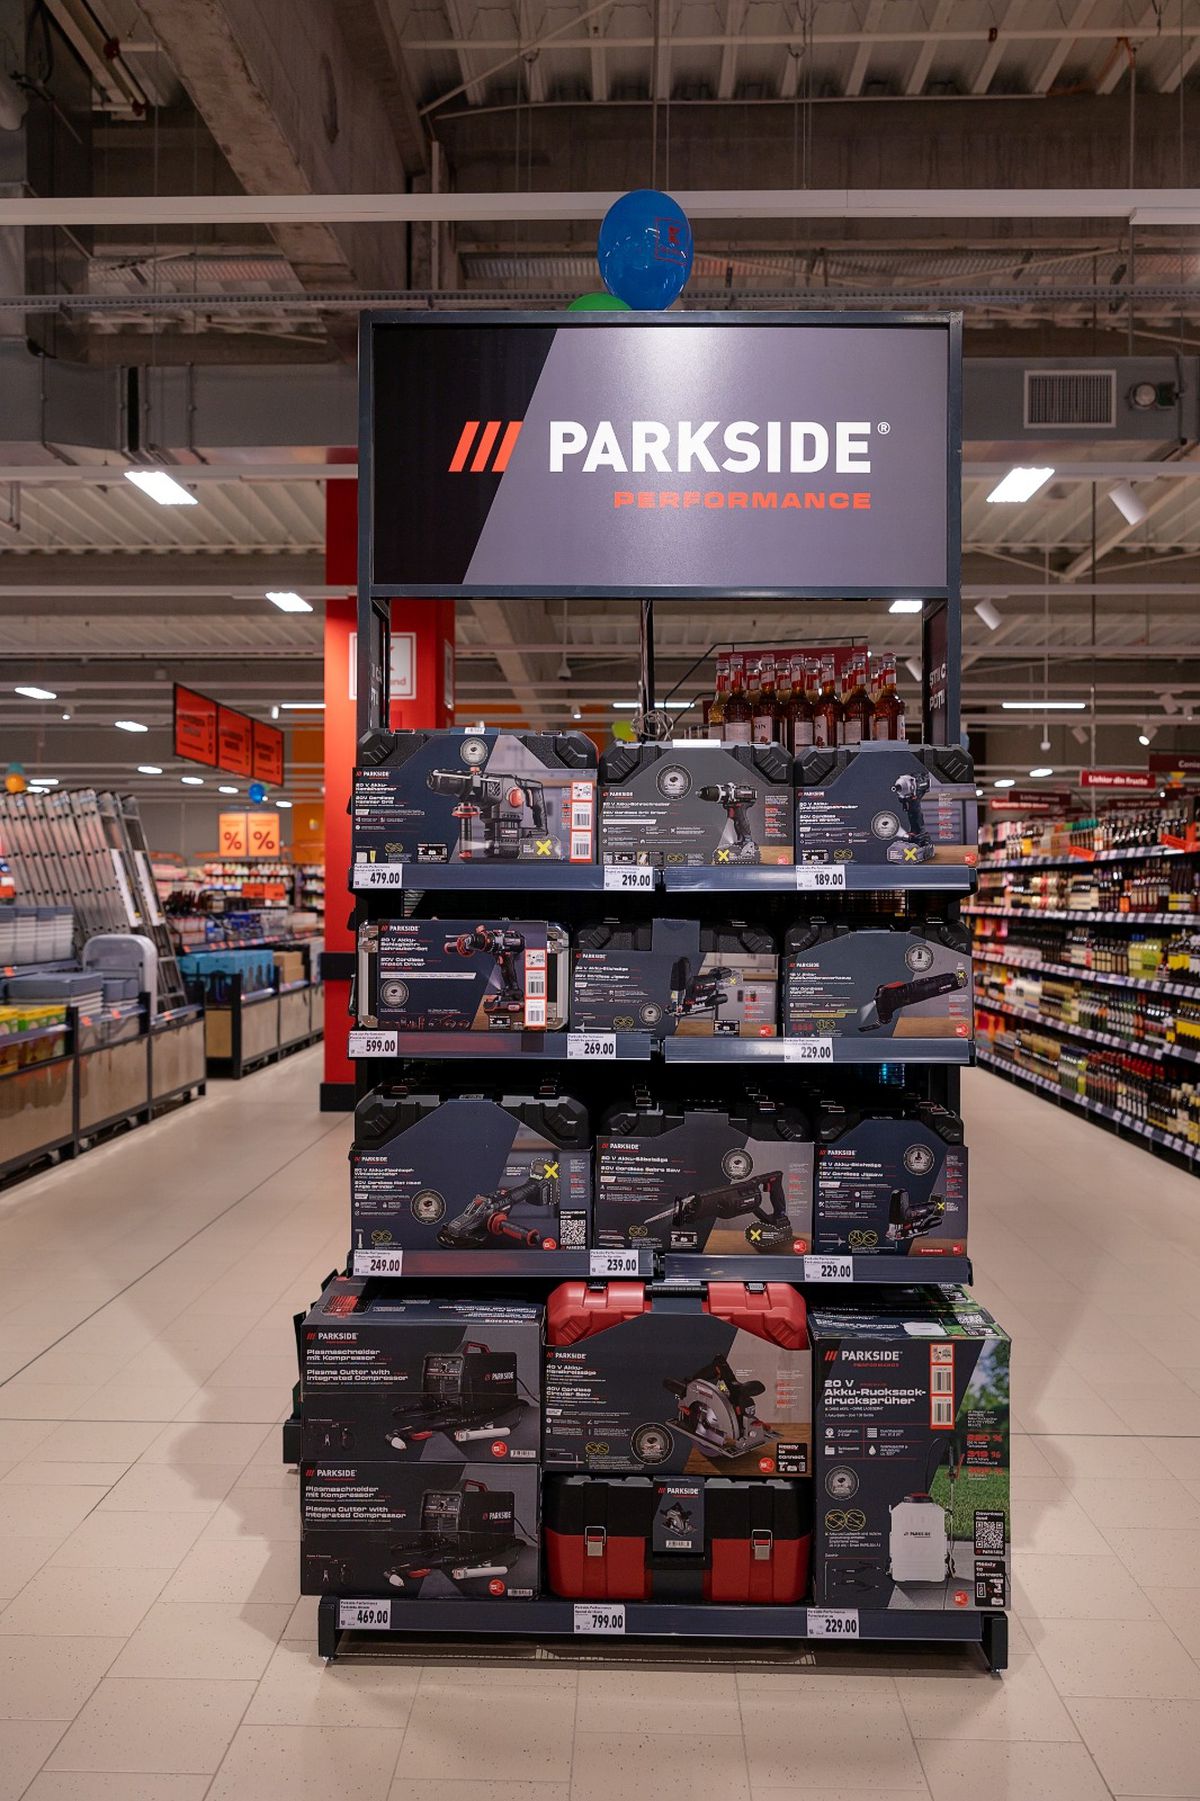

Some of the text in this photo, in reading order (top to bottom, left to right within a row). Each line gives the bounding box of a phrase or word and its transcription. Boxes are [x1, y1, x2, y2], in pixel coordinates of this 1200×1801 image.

[614, 492, 872, 508] PERFORMANCE
[370, 872, 400, 884] 479.00
[622, 875, 650, 886] 219.00
[815, 874, 843, 885] 189.00
[366, 1040, 395, 1052] 599.00
[584, 1043, 613, 1054] 269.00
[801, 1047, 830, 1058] 229.00
[370, 1260, 400, 1271] 249.00
[608, 1259, 636, 1271] 239.00
[821, 1265, 850, 1277] 229.00
[842, 1351, 899, 1360] PARKSIDE
[825, 1397, 915, 1405] drucksprüher
[357, 1610, 388, 1624] 469.00
[592, 1615, 623, 1629] 799.00
[826, 1619, 857, 1632] 229.00
